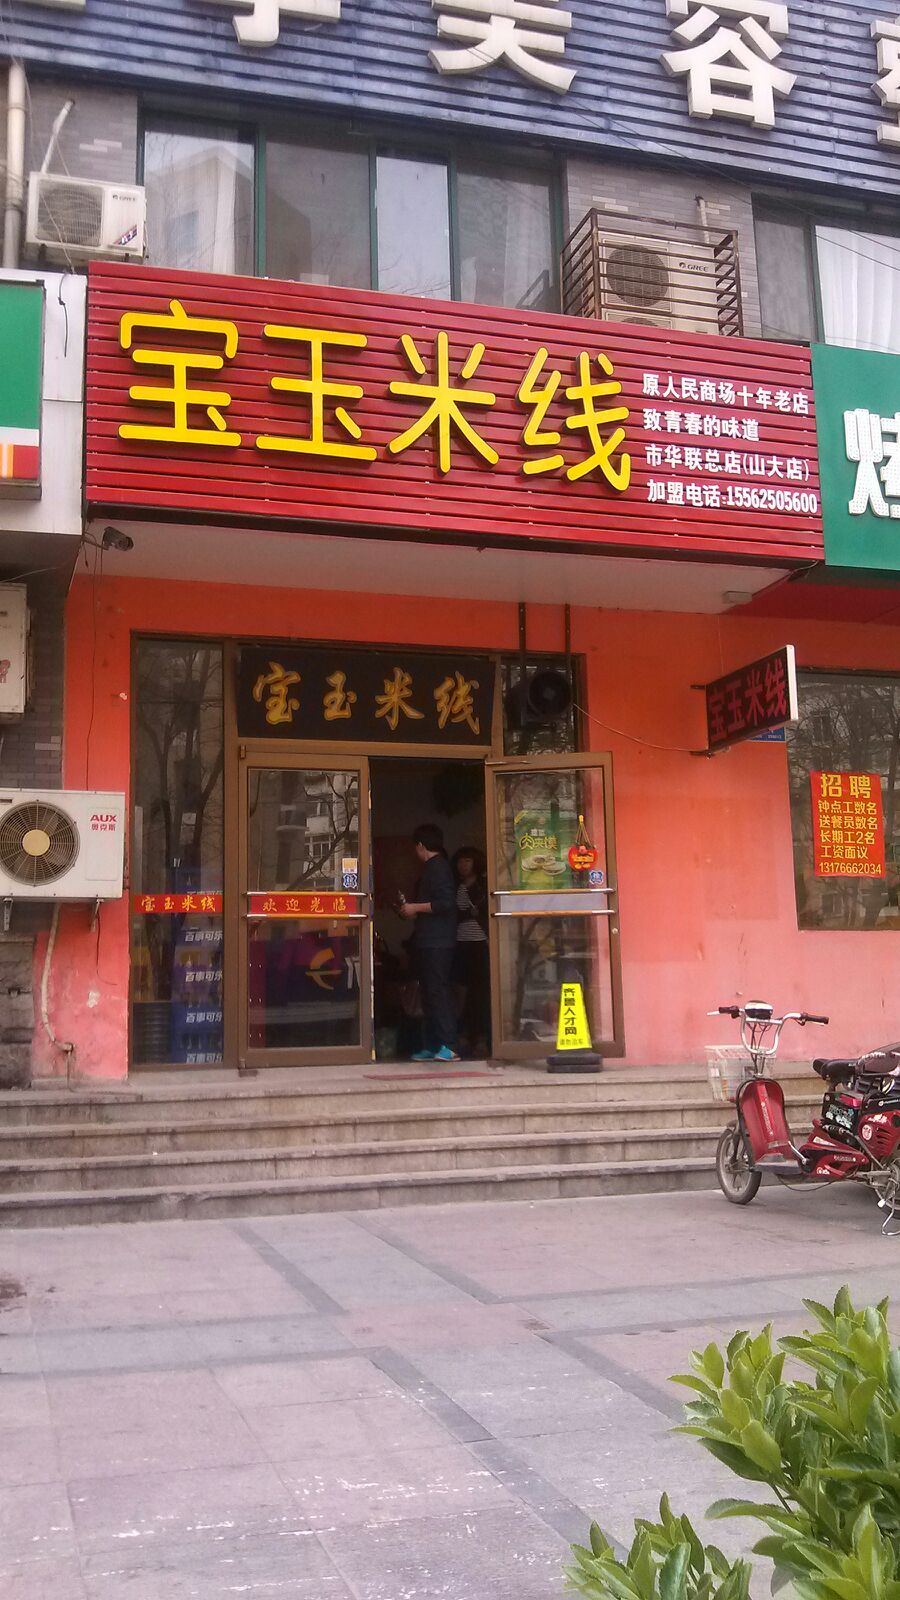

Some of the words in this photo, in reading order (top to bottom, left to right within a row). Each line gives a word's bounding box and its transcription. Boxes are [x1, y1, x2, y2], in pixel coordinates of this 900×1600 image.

[687, 264, 709, 272] GREE
[118, 299, 632, 492] 宝玉米线
[642, 373, 809, 414] 原人民商场十年老店
[642, 407, 760, 441] 致青春的味道
[644, 444, 809, 482] 市华联总店(山大店)
[646, 479, 818, 514] 加盟电话:15562505600
[252, 661, 480, 735] 宝玉米线
[708, 659, 787, 738] 宝玉米线
[820, 774, 872, 799] 招聘
[818, 800, 878, 815] 钟点工数名
[90, 814, 117, 823] AUX
[819, 815, 878, 831] 送餐员数名
[91, 823, 116, 832] 奥克斯
[820, 831, 876, 845] 长期工2名
[820, 846, 869, 860] 工资面议
[819, 862, 882, 875] 13176662034
[141, 895, 216, 912] 宝玉米线
[262, 897, 347, 913] 欢迎光临
[563, 988, 577, 1035] 齐鲁人才网
